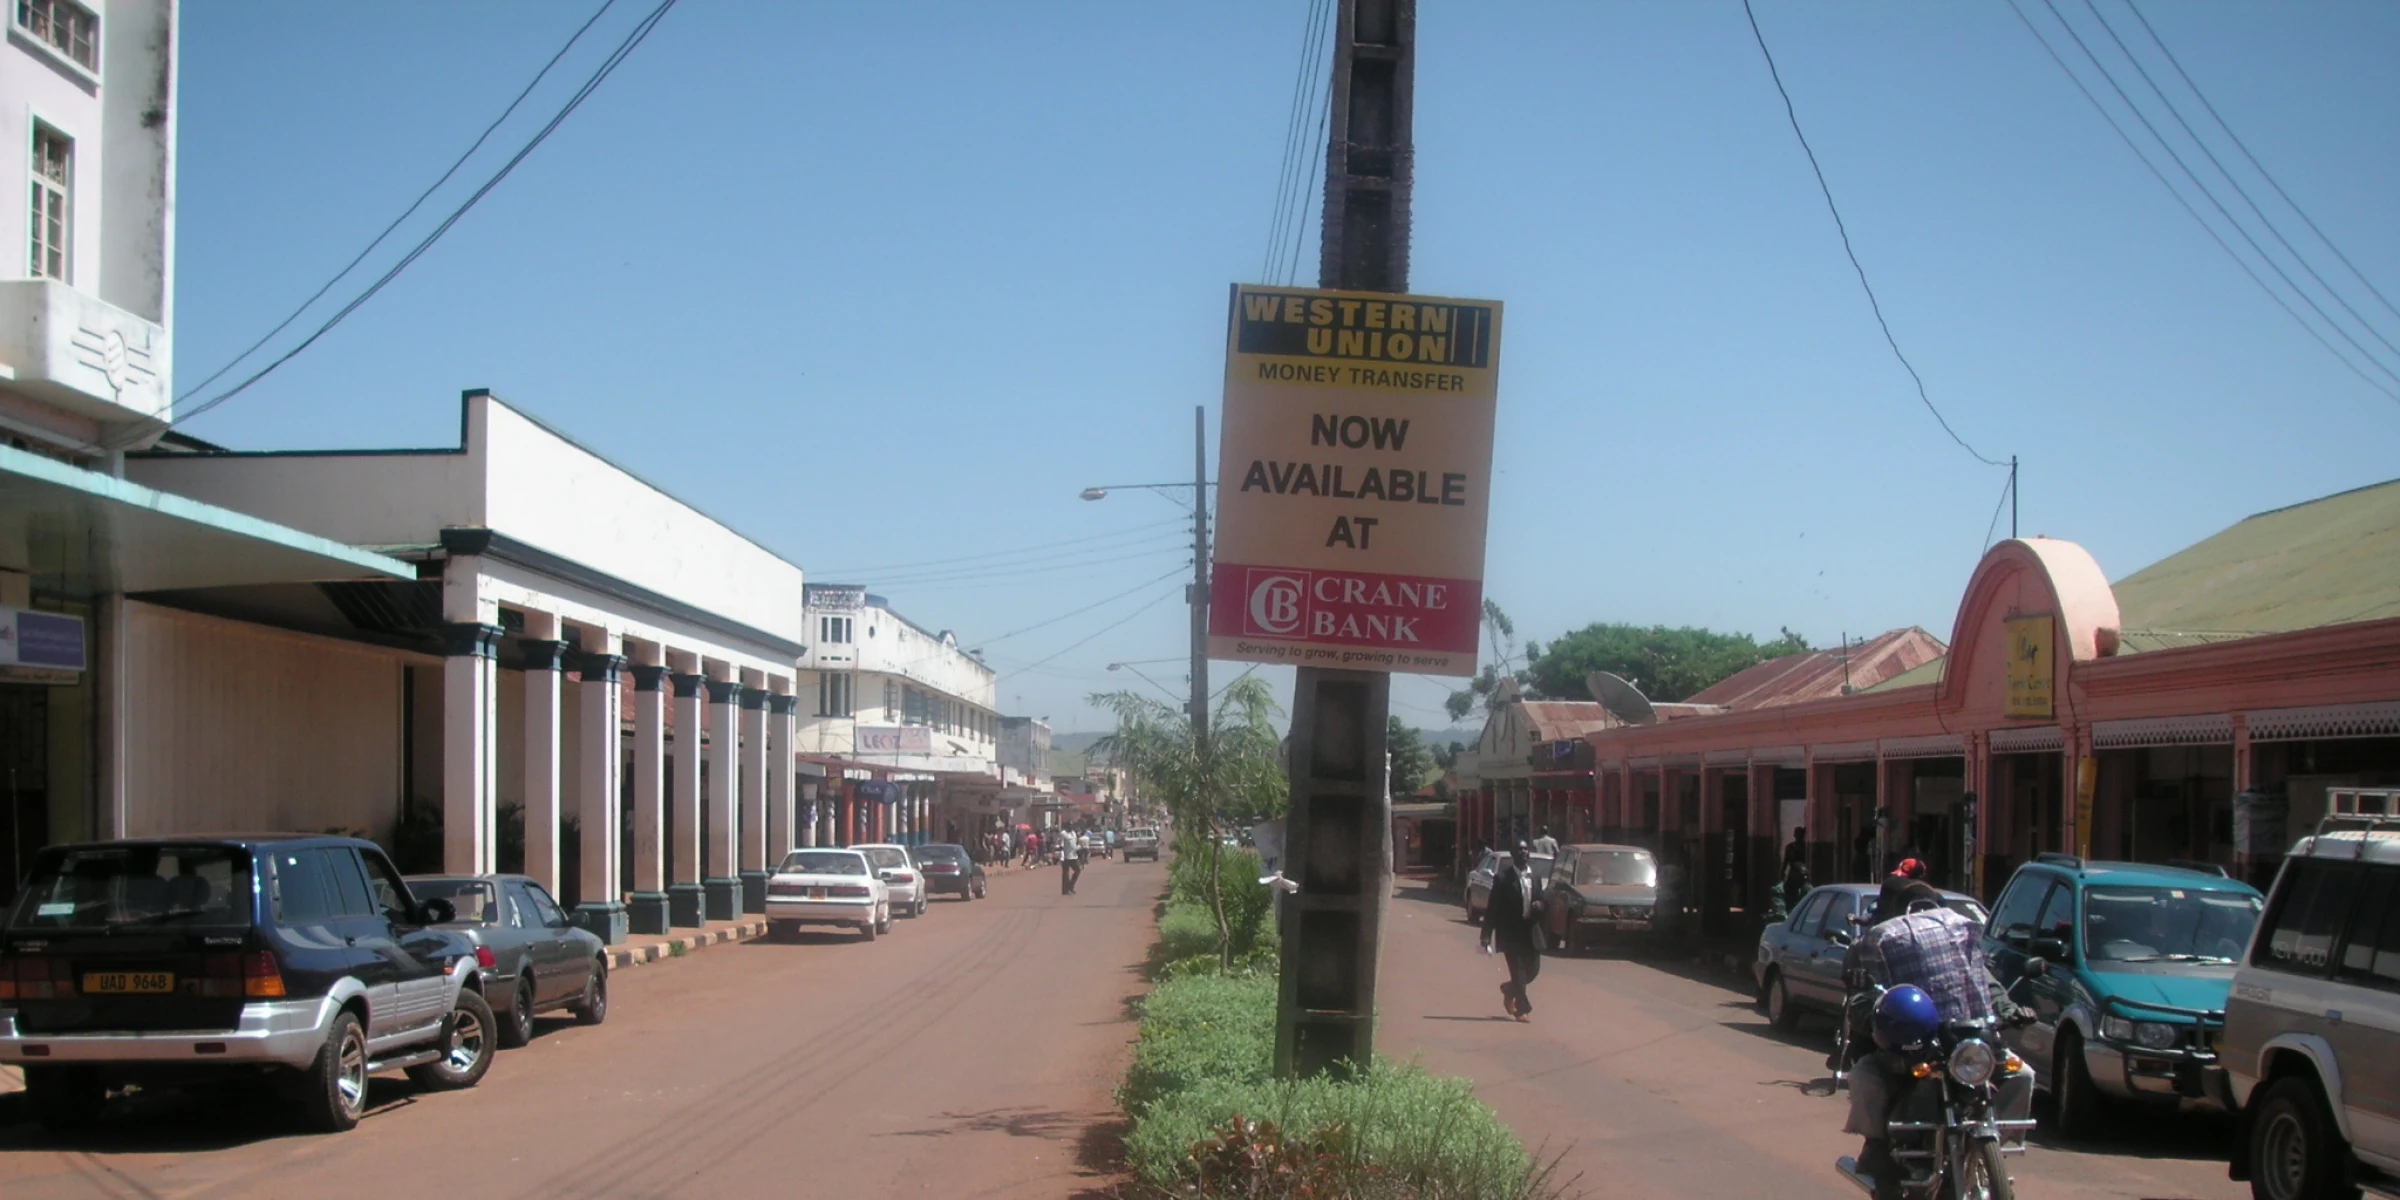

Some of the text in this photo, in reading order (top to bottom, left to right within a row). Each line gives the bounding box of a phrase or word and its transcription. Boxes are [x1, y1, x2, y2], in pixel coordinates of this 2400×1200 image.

[1244, 294, 1447, 332] WESTERN
[1307, 327, 1446, 362] UNION
[1258, 362, 1464, 392] MONEY TRANSFER
[1311, 413, 1410, 451] NOW
[1241, 460, 1467, 506] AVAILABLE
[1325, 516, 1378, 550] AT
[1314, 576, 1448, 610] CRANE
[1313, 610, 1420, 643] BANK
[1236, 641, 1449, 667] Serving to grow, growing to serve
[100, 974, 126, 991] UAD
